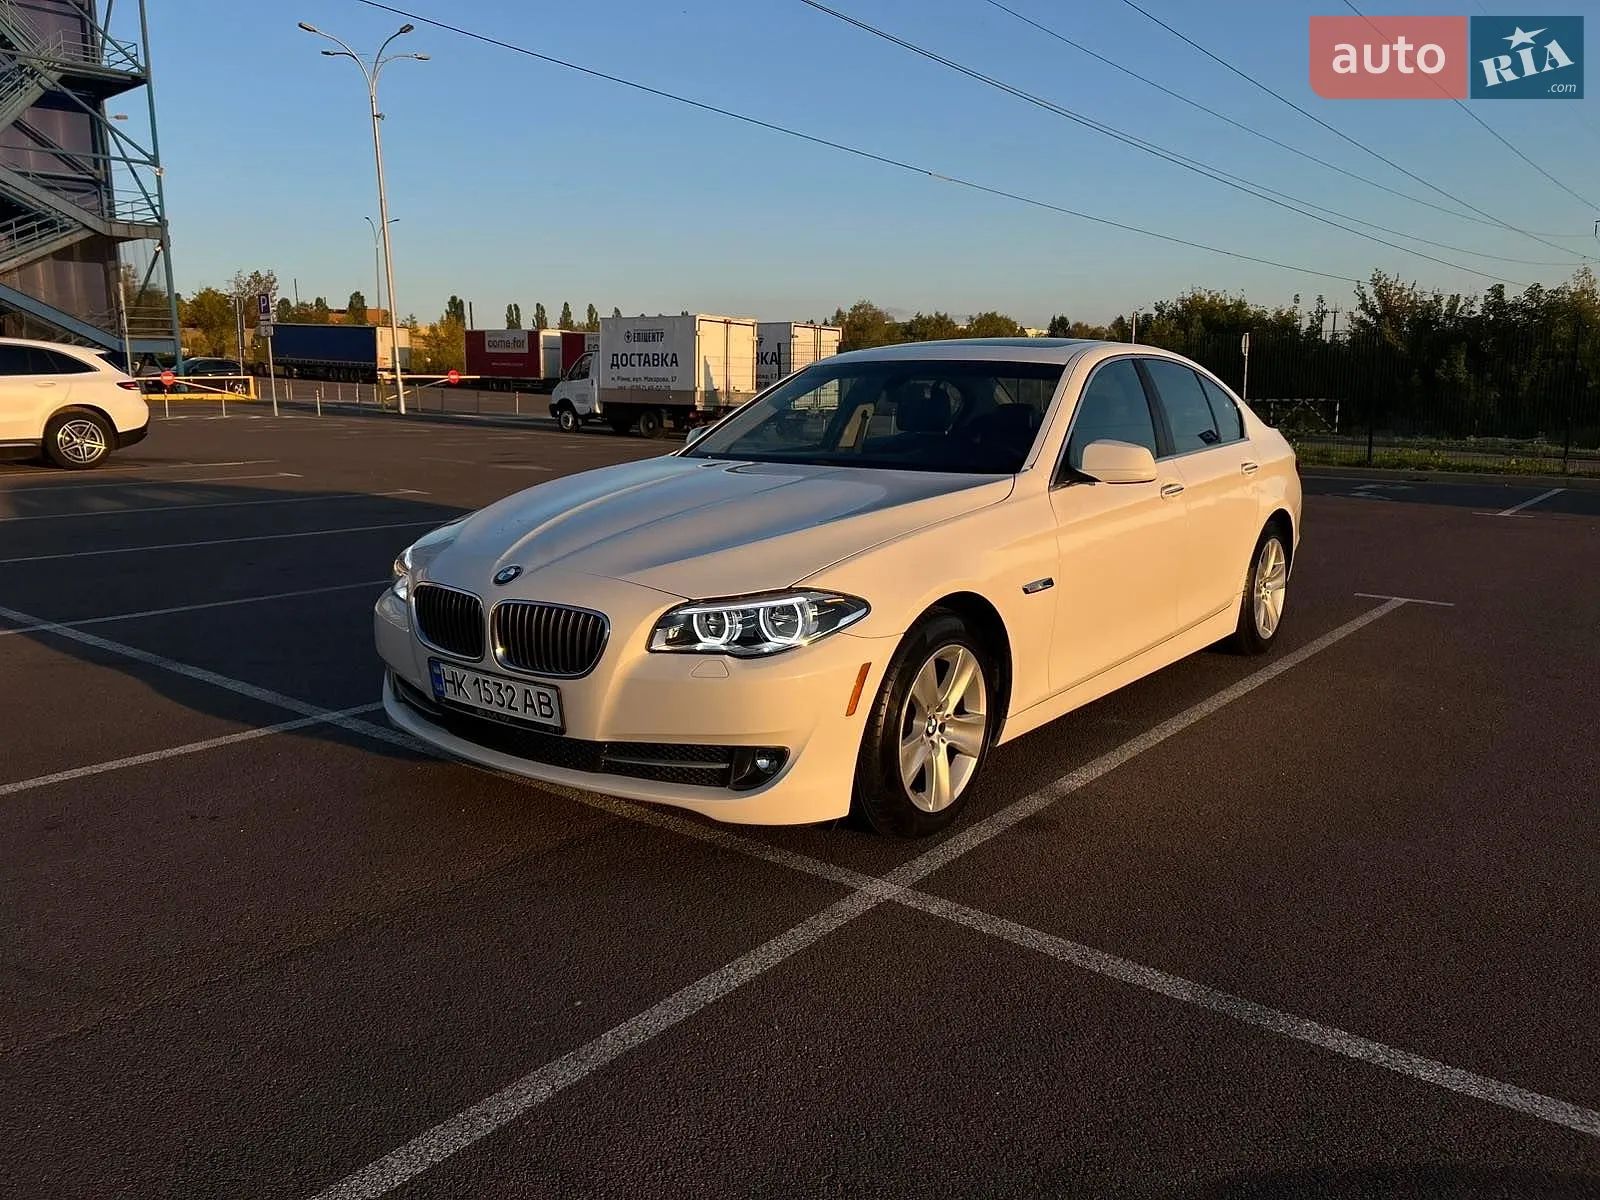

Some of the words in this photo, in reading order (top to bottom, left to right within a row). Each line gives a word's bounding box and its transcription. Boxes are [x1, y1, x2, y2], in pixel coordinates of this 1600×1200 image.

[260, 296, 267, 312] P
[610, 353, 678, 369] ДОСТАВКА
[441, 668, 472, 700] HK
[473, 677, 519, 712] 1532
[524, 688, 554, 719] AB
